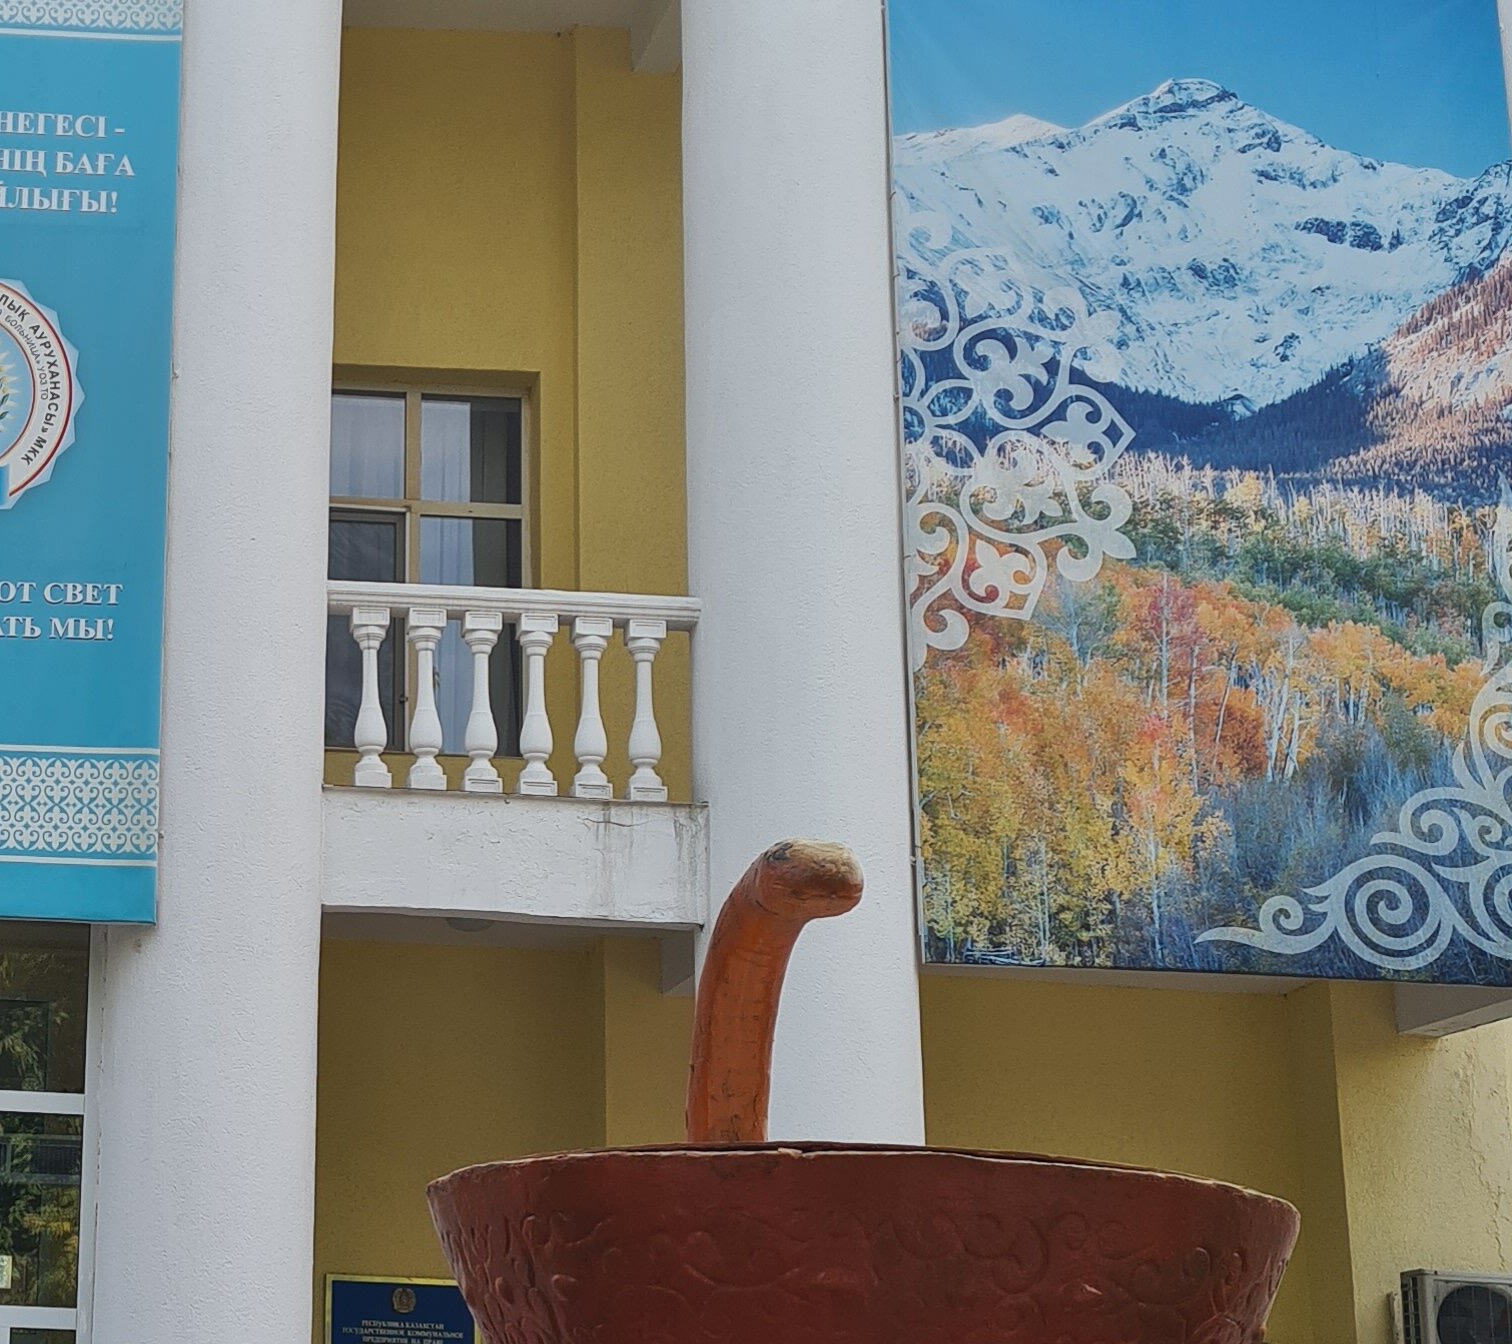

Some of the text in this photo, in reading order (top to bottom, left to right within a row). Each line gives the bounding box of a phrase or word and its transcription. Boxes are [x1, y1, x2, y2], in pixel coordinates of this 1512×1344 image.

[55, 152, 136, 177] БАҒА
[43, 581, 123, 605] СВЕТ
[49, 617, 114, 640] МЫ!
